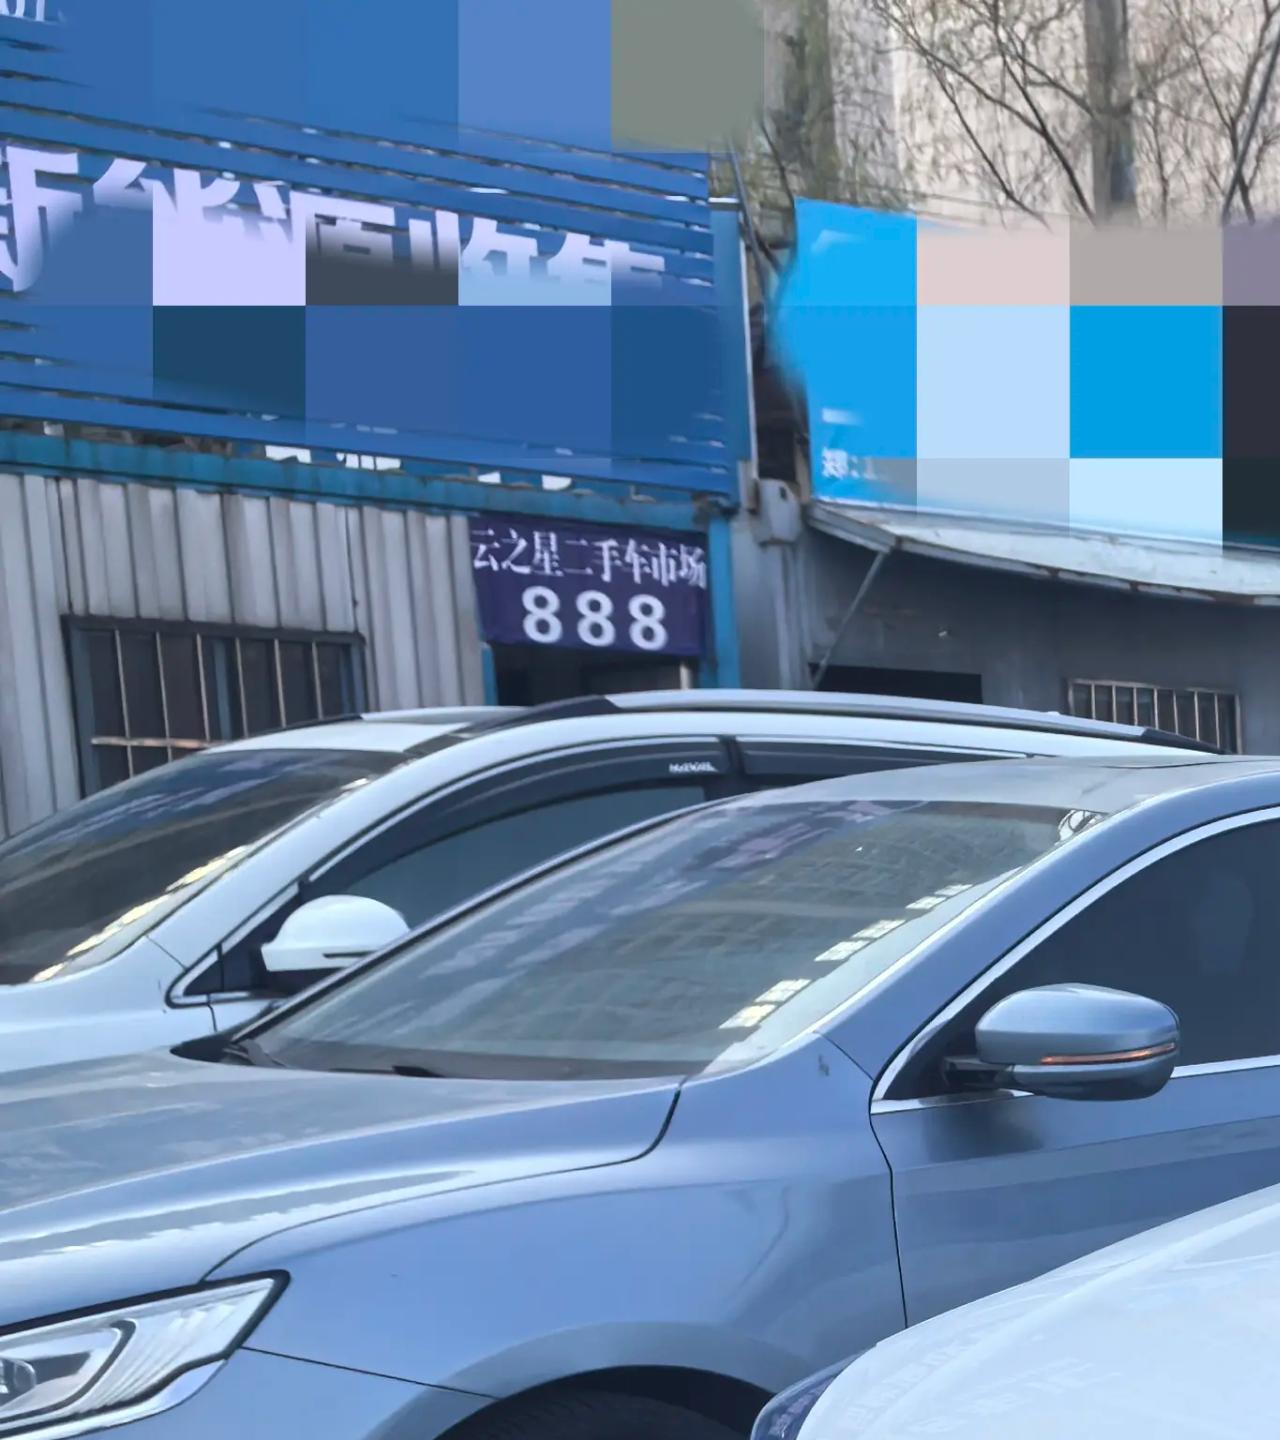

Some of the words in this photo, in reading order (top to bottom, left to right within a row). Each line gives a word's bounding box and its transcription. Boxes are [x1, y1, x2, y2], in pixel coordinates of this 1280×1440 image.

[470, 527, 708, 590] 云之星二手车市场
[520, 585, 669, 651] 888
